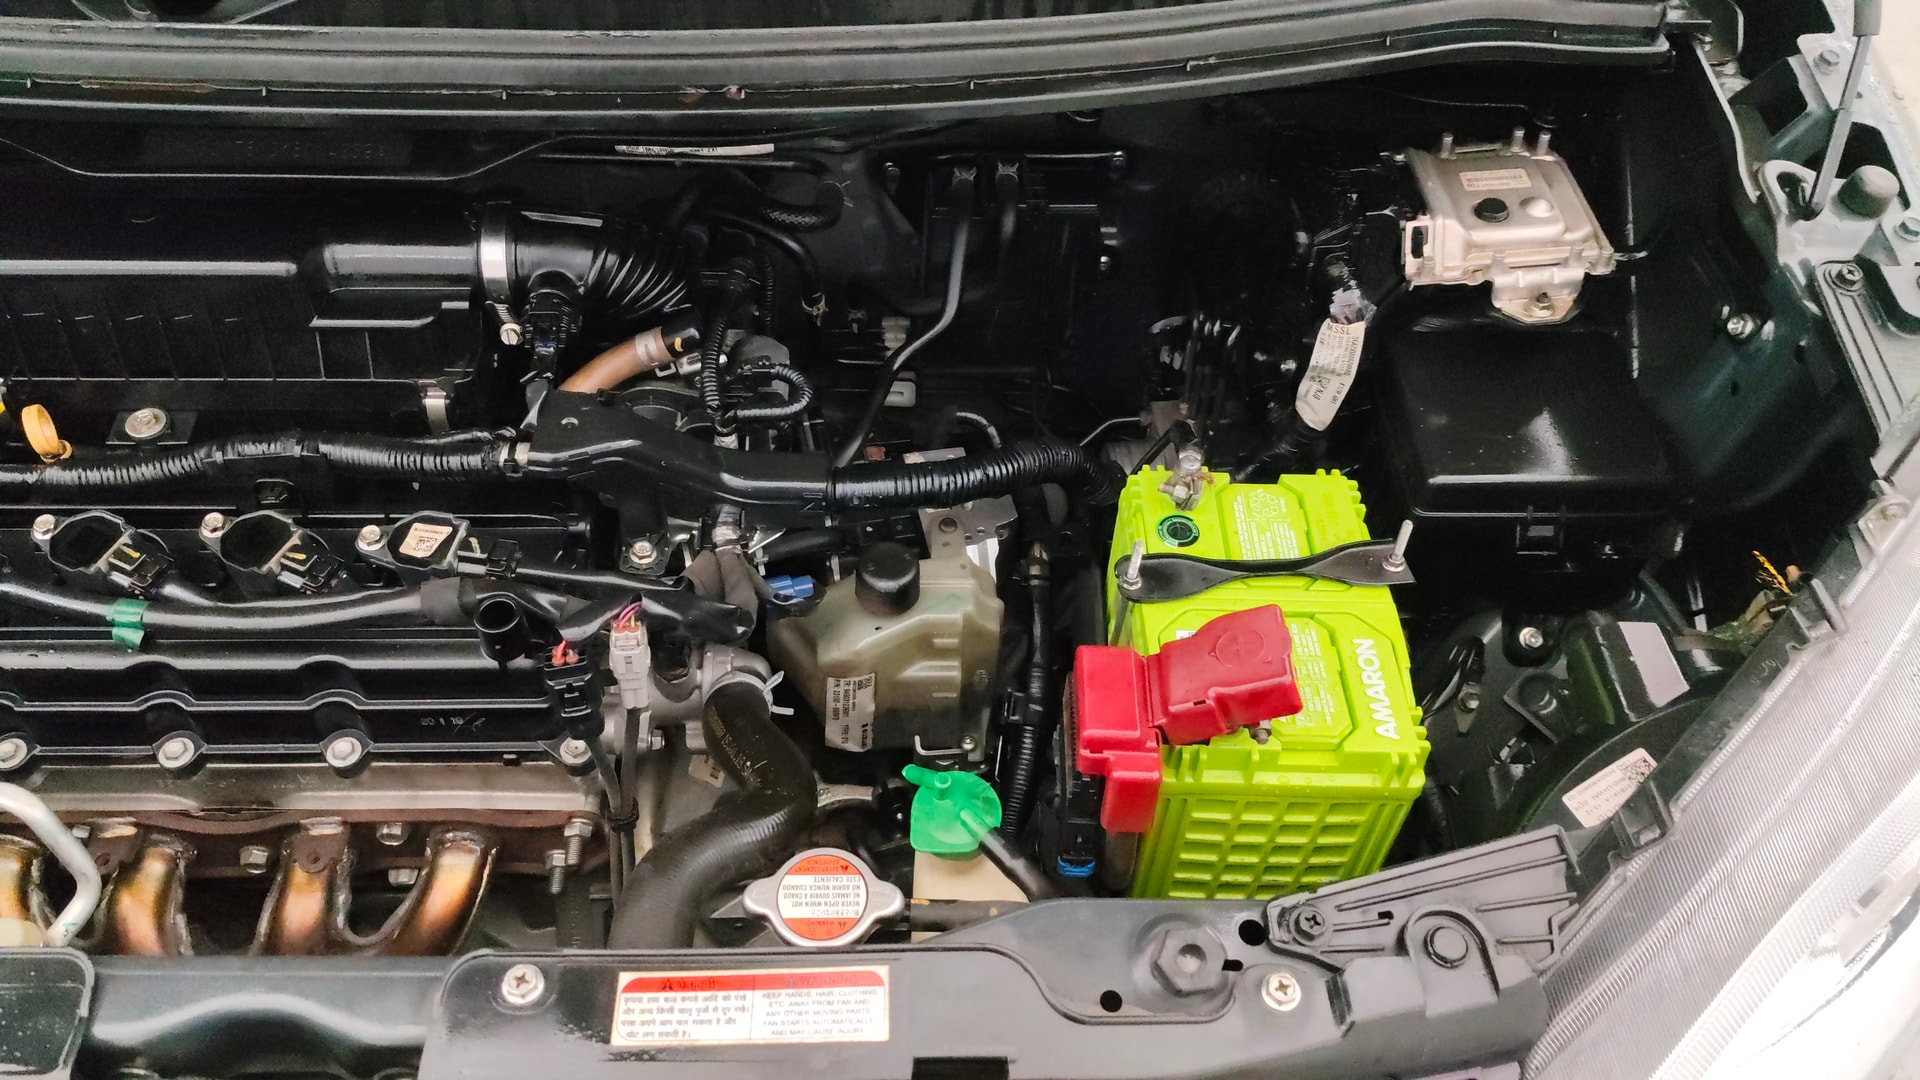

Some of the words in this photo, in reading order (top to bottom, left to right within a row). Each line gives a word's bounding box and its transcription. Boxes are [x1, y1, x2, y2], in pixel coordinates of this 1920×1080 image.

[1326, 323, 1351, 335] MSSL
[1352, 638, 1400, 740] AMARON
[795, 865, 839, 873] AVERTISSEMENT
[804, 900, 823, 908] WHEN
[824, 900, 840, 908] OPEN
[841, 900, 860, 908] NEVER
[801, 975, 858, 986] WARNING
[762, 991, 783, 999] KEEP
[838, 989, 878, 997] CLOTHING
[788, 1000, 810, 1008] AWAY
[812, 999, 834, 1007] FROM
[837, 998, 852, 1006] FAN
[853, 998, 870, 1006] AND
[765, 1010, 781, 1018] ANY
[783, 1009, 810, 1017] OTHER
[813, 1008, 843, 1016] MOVING
[813, 1018, 873, 1026] AUTOMATICALLY
[789, 1028, 805, 1036] MAY
